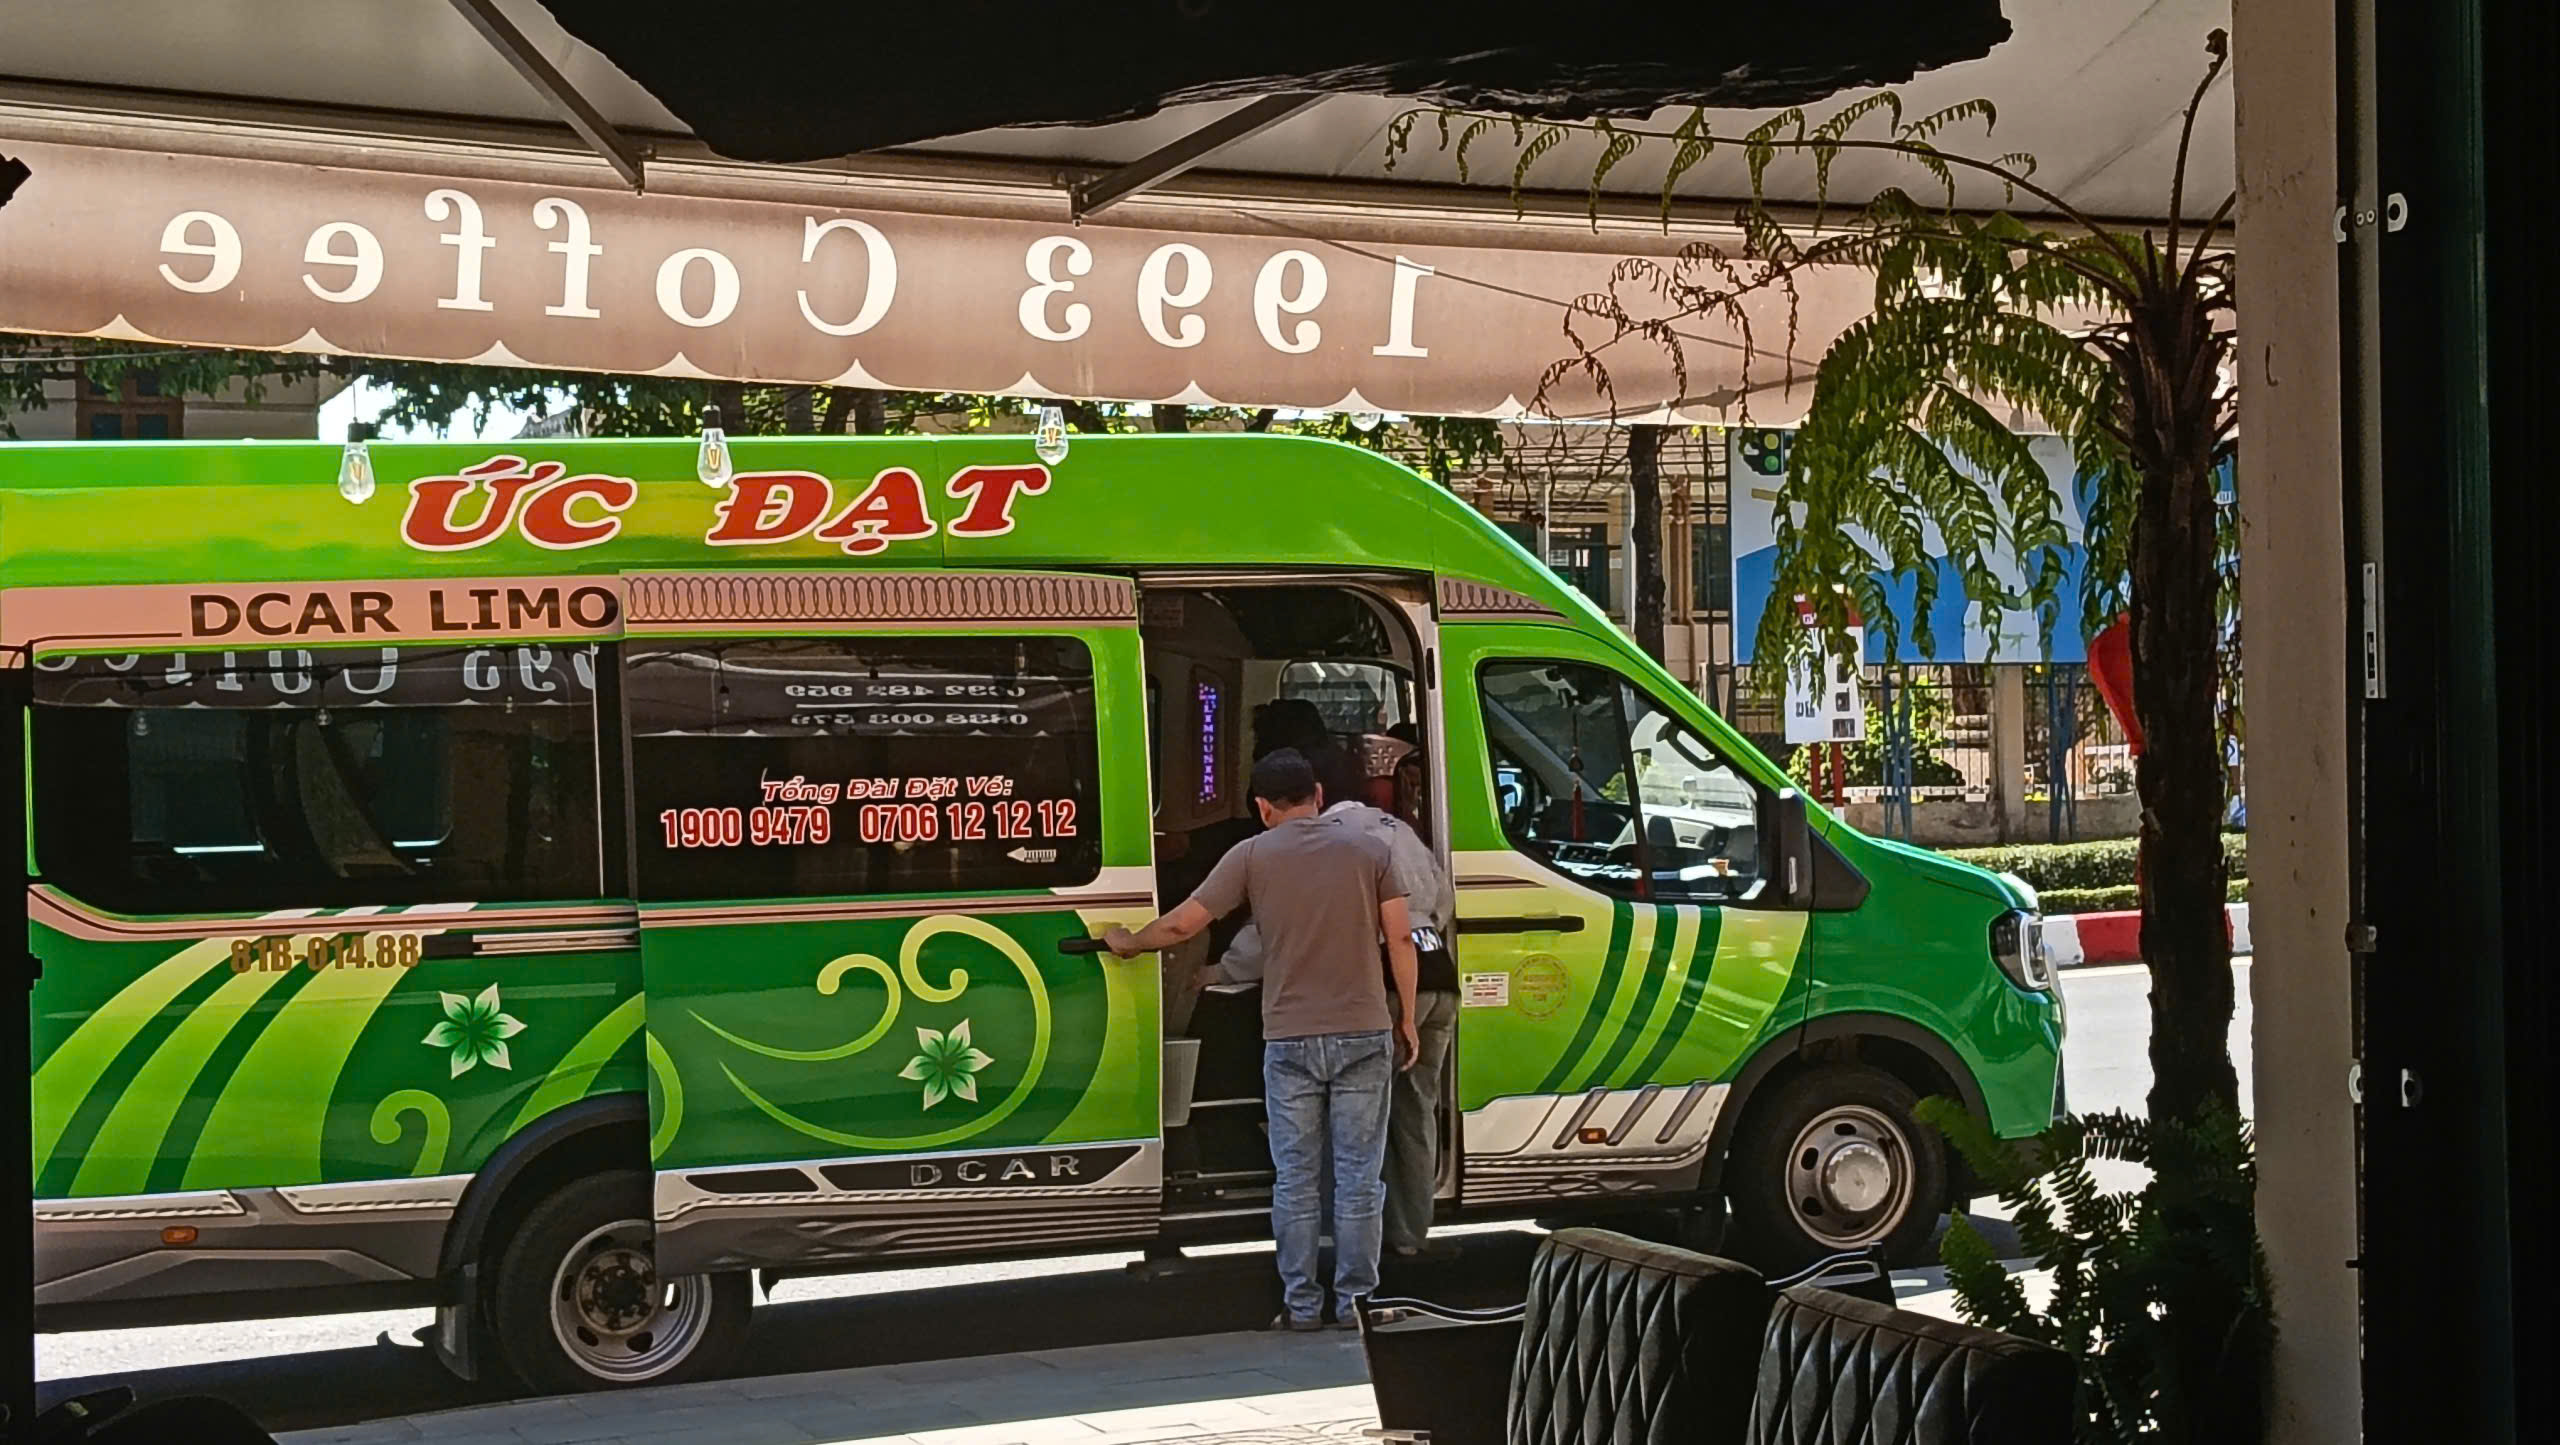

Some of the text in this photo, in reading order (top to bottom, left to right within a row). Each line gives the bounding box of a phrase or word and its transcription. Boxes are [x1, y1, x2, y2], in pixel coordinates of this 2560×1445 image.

[400, 454, 1052, 556] ỨC ĐẠT
[190, 586, 619, 637] DCAR LIMO
[762, 776, 840, 804] Tổng
[847, 778, 899, 799] Đài
[905, 777, 958, 801] Đặt
[660, 799, 1077, 848] 1900 9479 0706 12 12 12
[230, 934, 419, 973] 81B-014.88
[910, 1154, 1080, 1187] DCAR
